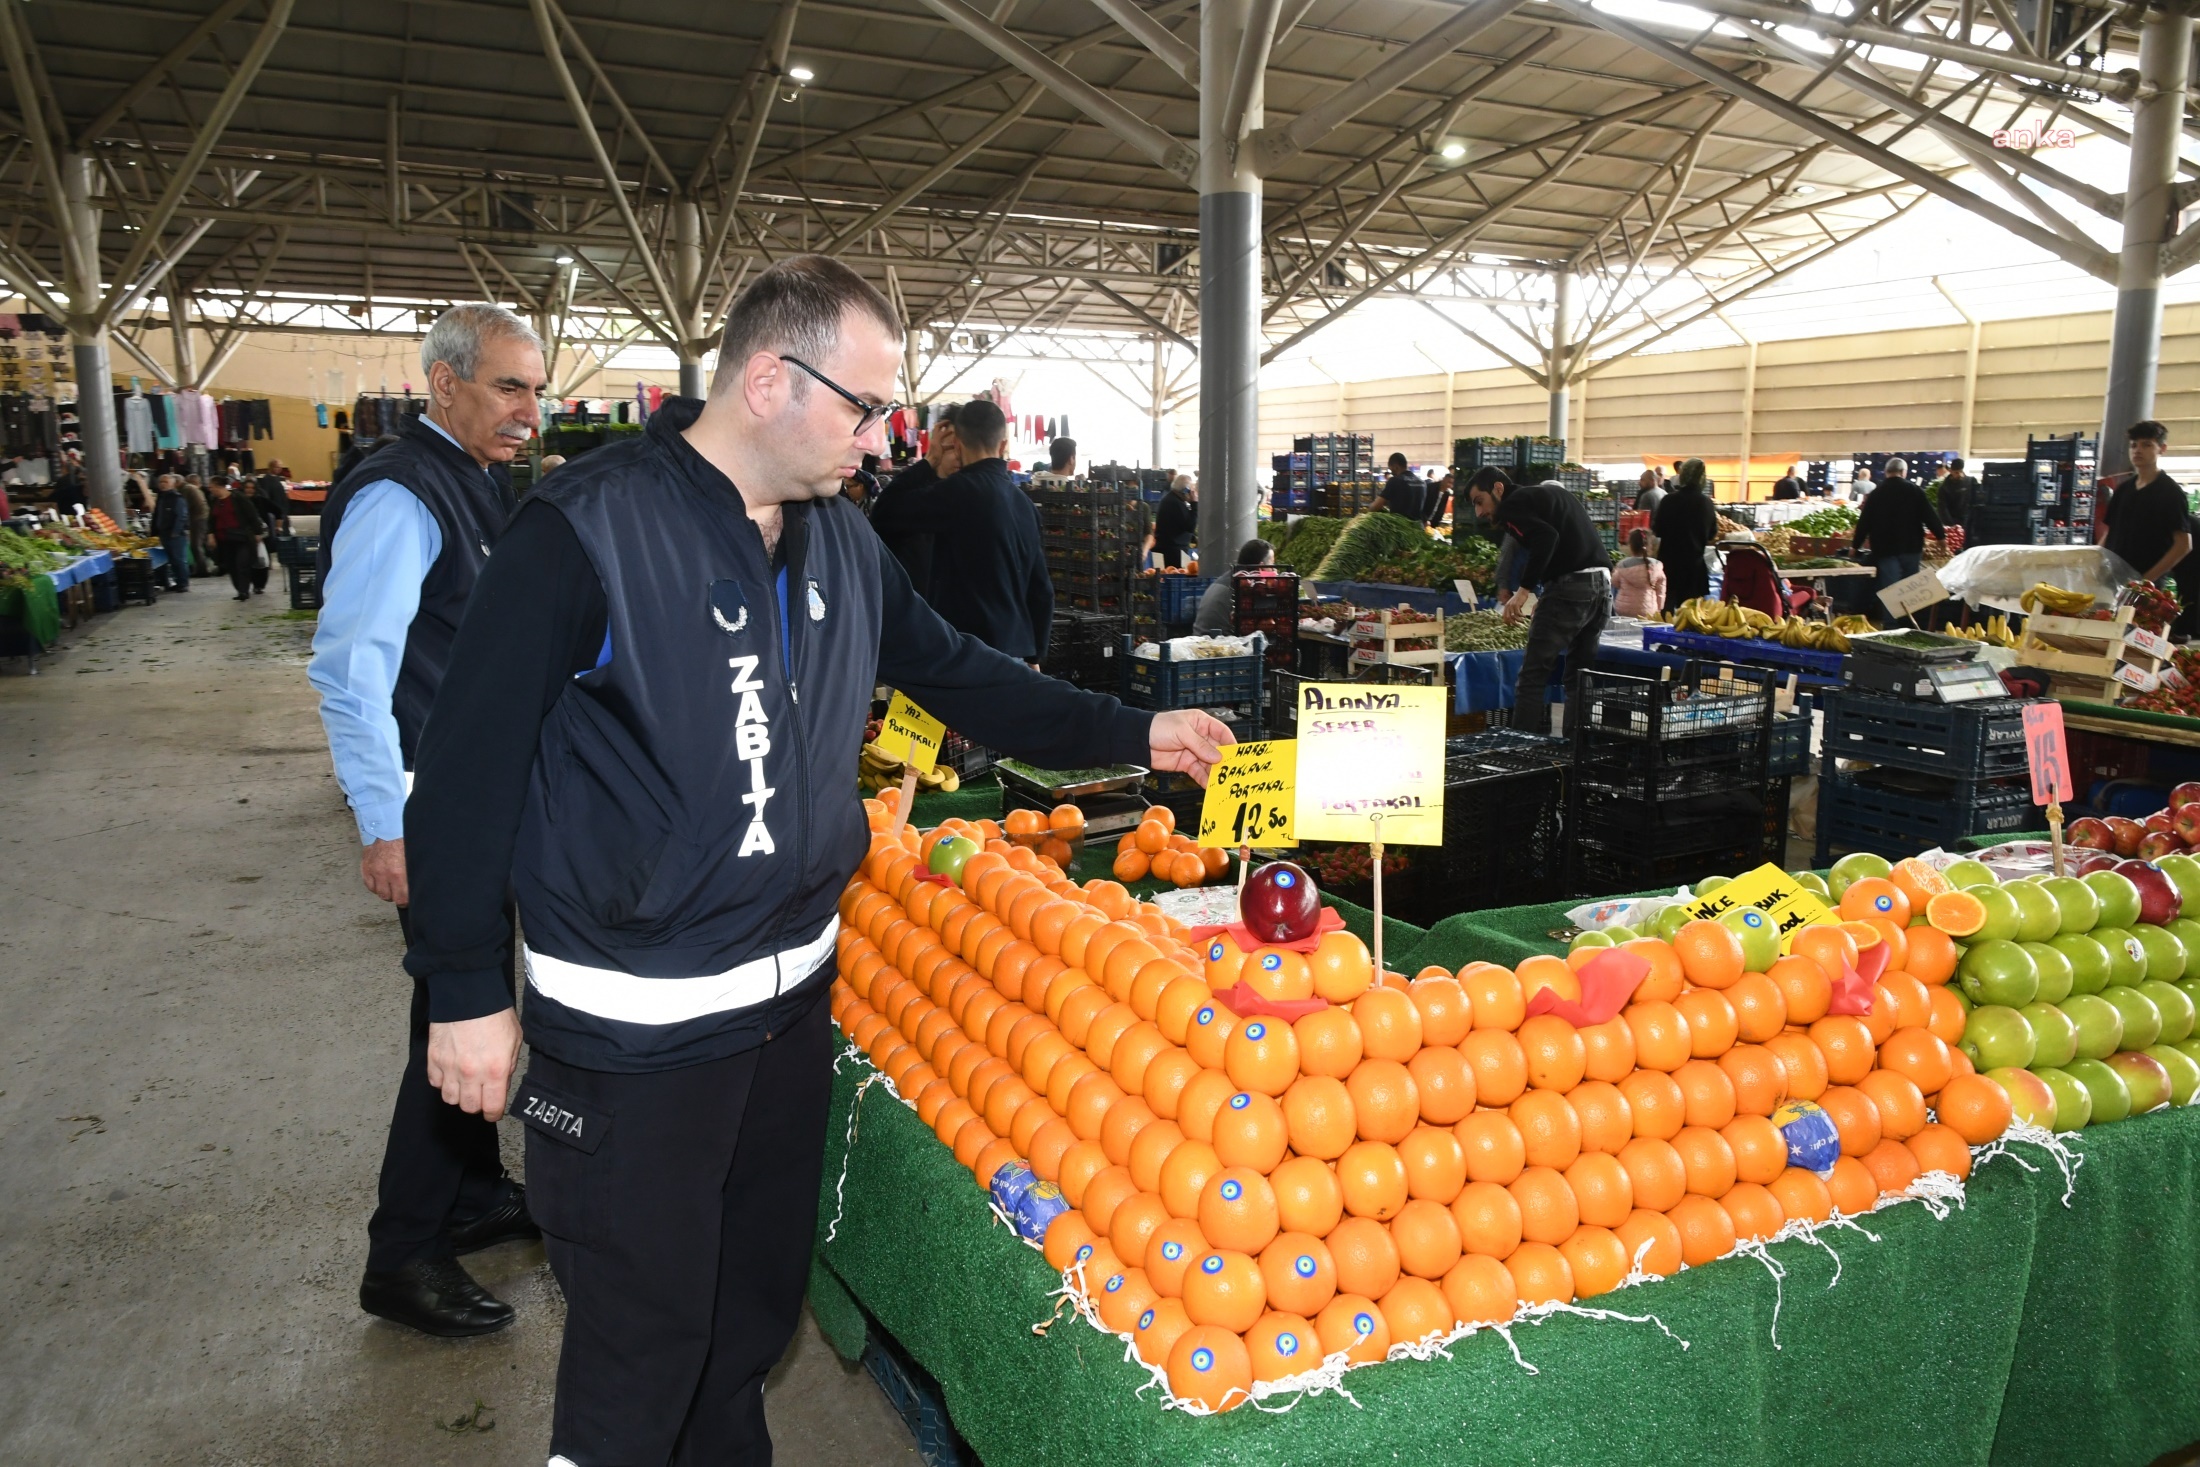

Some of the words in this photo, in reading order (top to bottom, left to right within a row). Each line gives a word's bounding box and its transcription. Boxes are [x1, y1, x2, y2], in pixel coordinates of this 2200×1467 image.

[1304, 687, 1400, 710] ALANYA
[905, 704, 921, 720] YAZ
[889, 718, 937, 749] PORTAKALI
[728, 654, 776, 857] ZABITA
[1217, 761, 1271, 785] BAKLAVA
[1229, 780, 1284, 800] PORTAKAL
[523, 1096, 583, 1137] ZABITA
